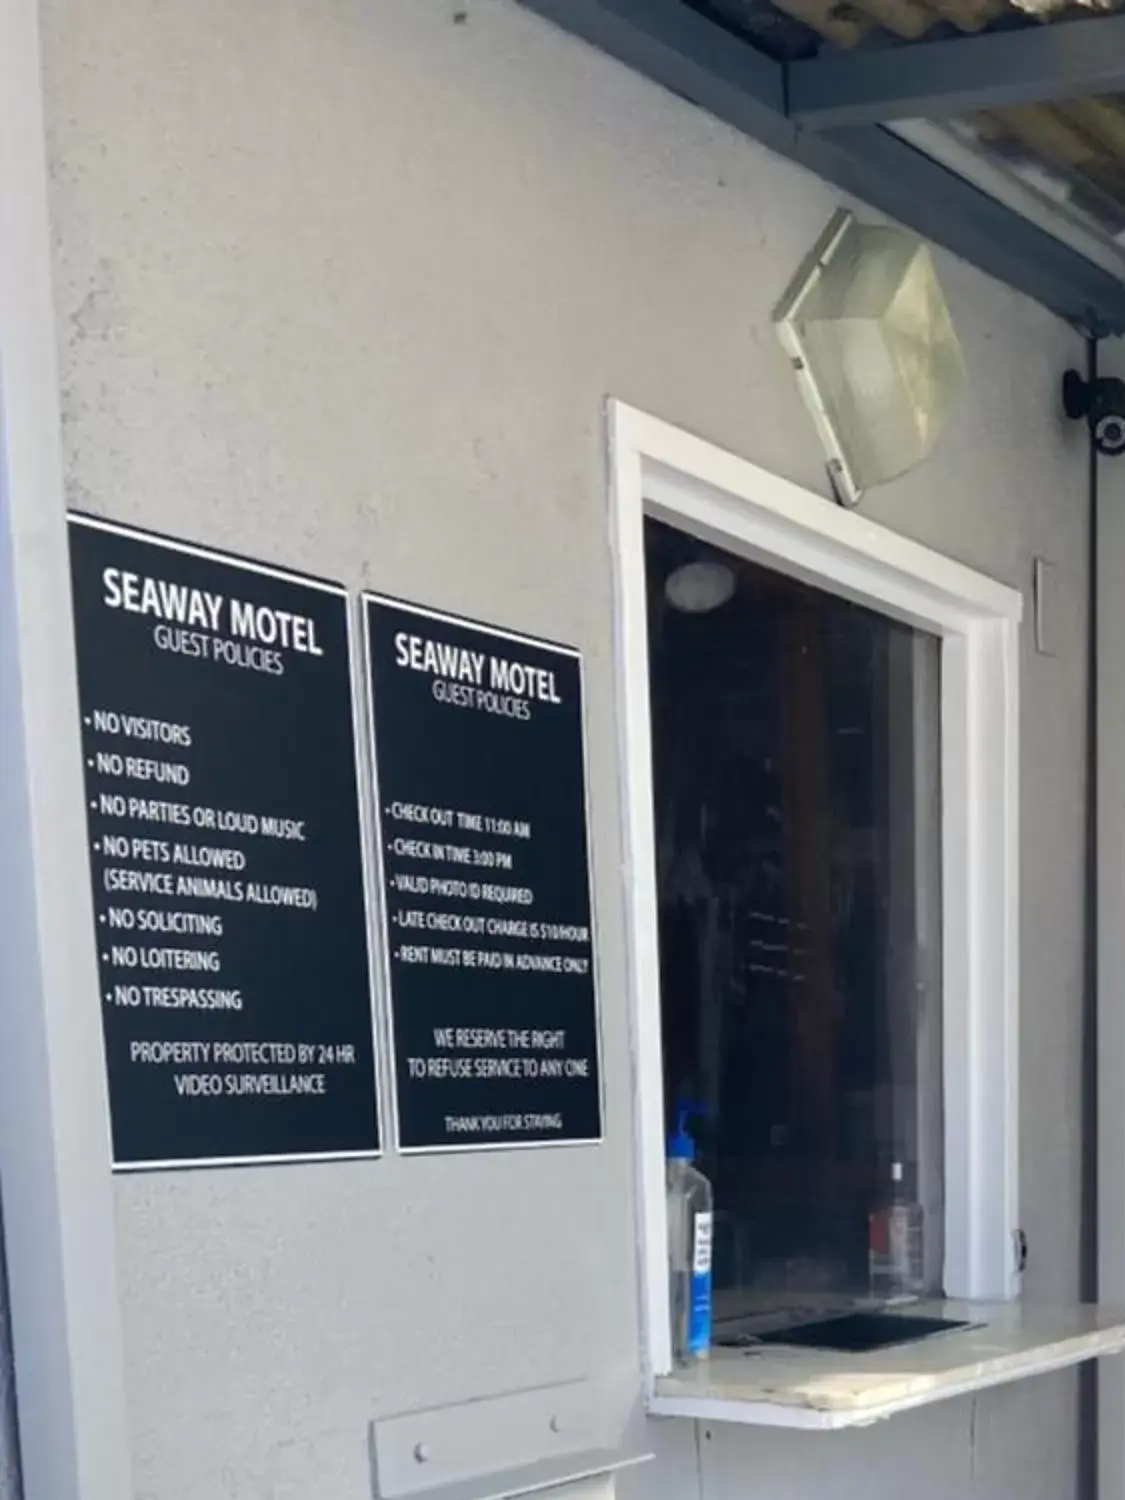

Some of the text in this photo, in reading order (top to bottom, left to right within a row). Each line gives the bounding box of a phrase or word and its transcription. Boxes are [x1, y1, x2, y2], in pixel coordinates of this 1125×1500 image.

[103, 567, 323, 655] SEAWAY MOTEL
[154, 624, 284, 675] GUEST POLICIES
[395, 633, 561, 703] SEAWAY MOTEL
[432, 680, 531, 720] GUEST POLICIES
[94, 710, 192, 746] NO VISITORS
[98, 753, 189, 785] NO REFUND
[100, 794, 305, 840] NO PARTIES OR LOUD MUSIC
[391, 802, 429, 823] CHECK
[430, 808, 453, 827] OUT
[457, 812, 483, 831] TIME
[514, 821, 530, 839] AM
[103, 836, 245, 871] NO PETS ALLOWED
[394, 839, 431, 858] CHECK
[432, 844, 445, 860] IN
[446, 846, 471, 863] TIME
[496, 853, 512, 869] PM
[104, 868, 317, 911] (SERVICE ANIMALS ALLOWED)
[395, 874, 429, 893] VALID
[430, 877, 467, 898] PHOTO
[482, 884, 533, 905] REQUIRED
[109, 908, 222, 936] NO SOLICITING
[398, 910, 425, 927] LATE
[427, 913, 462, 932] CHECK
[463, 916, 485, 934] OUT
[112, 947, 220, 971] NO LOITERING
[401, 945, 589, 974] RENT MUST BE PAID IN ADVANCE ONLY
[115, 985, 243, 1010] NO TRESPASSING
[130, 1041, 355, 1064] PROPERTY PROTECTED BY 24 HR
[433, 1028, 565, 1049] WE RESERVE THE RIGHT
[407, 1058, 589, 1078] TO REFUSE SERVICE TO ANY ONE
[174, 1073, 326, 1096] VIDEO SURVEILLANCE
[444, 1113, 562, 1132] THANK YOU FOR STAYING
